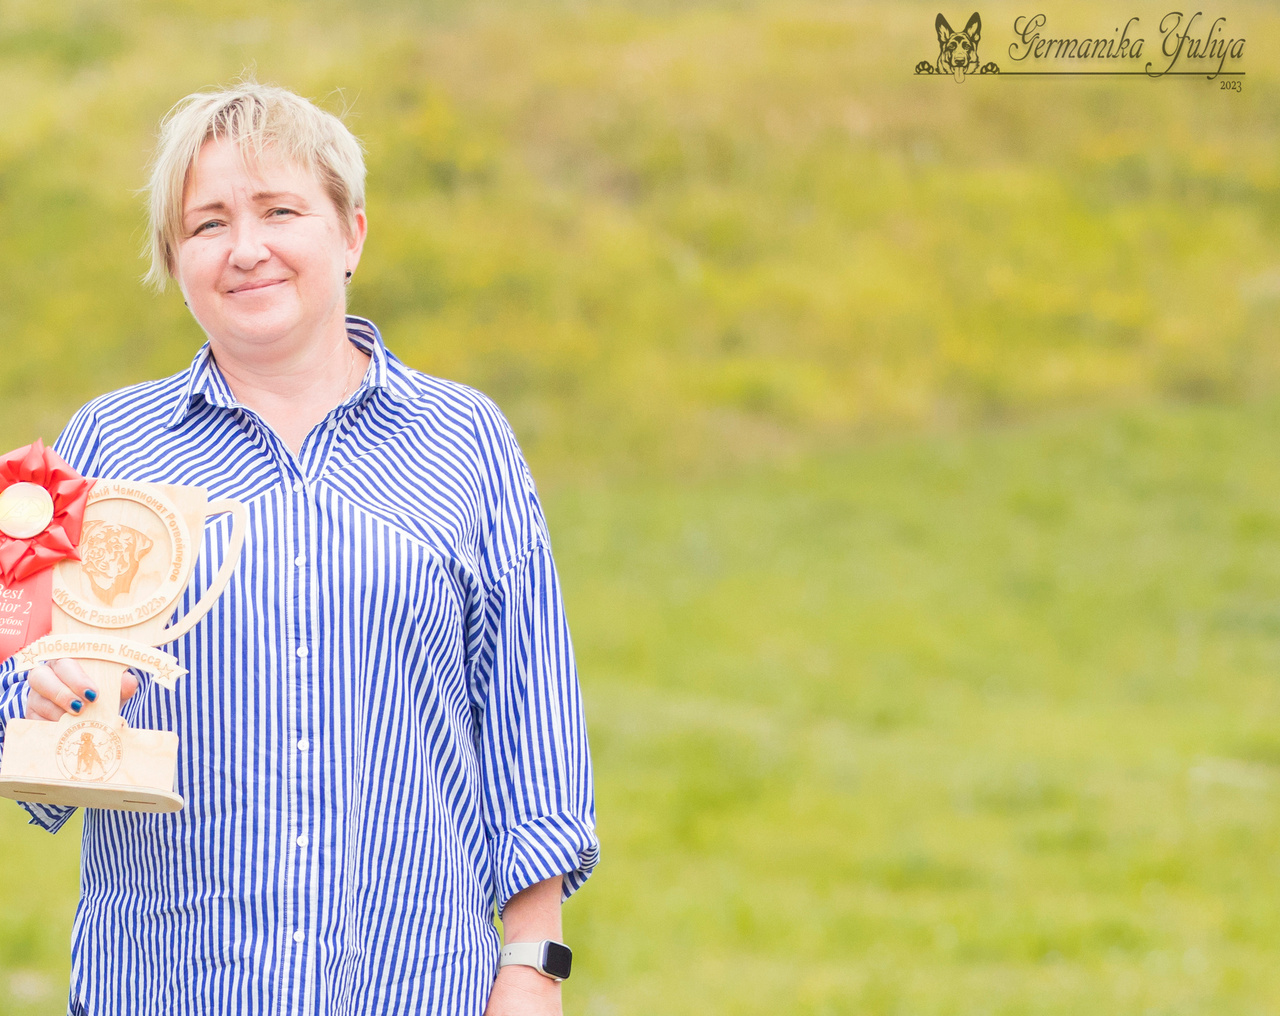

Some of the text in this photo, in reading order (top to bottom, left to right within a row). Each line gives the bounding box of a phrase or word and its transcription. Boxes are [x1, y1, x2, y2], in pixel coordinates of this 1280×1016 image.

[113, 484, 186, 582] Чемпионат Ротвейлеров
[22, 601, 33, 614] 2
[53, 587, 167, 625] «Кубок Рязани 2023»
[37, 639, 162, 669] Победитель Класса
